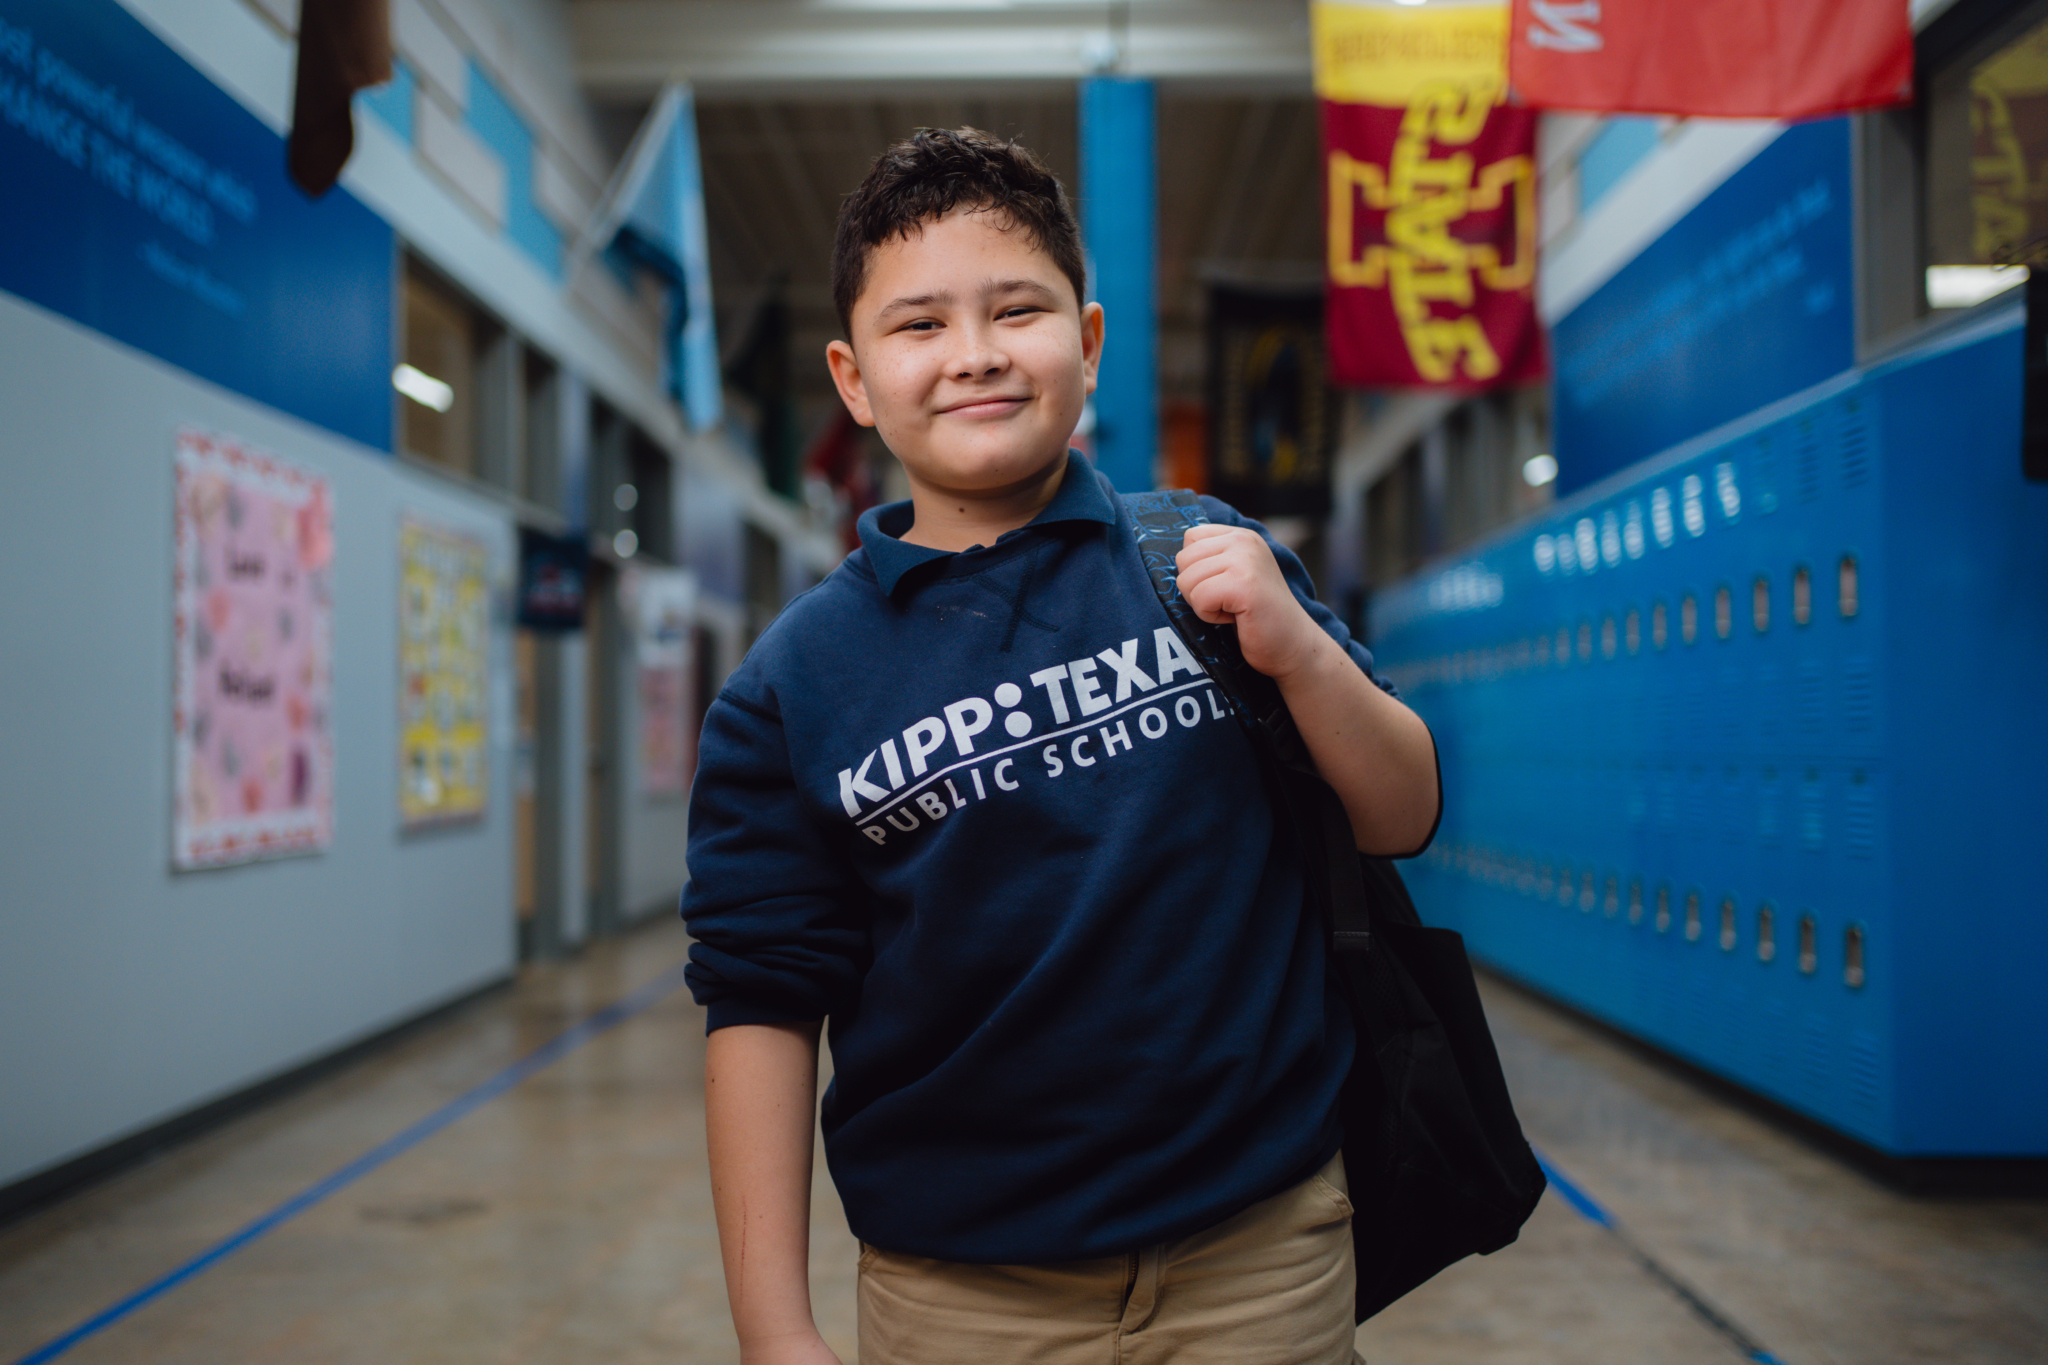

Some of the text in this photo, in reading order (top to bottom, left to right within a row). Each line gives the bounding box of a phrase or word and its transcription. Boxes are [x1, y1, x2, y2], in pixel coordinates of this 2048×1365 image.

[1029, 626, 1205, 725] TEXA
[862, 688, 1236, 846] PUBLIC SCHOOL
